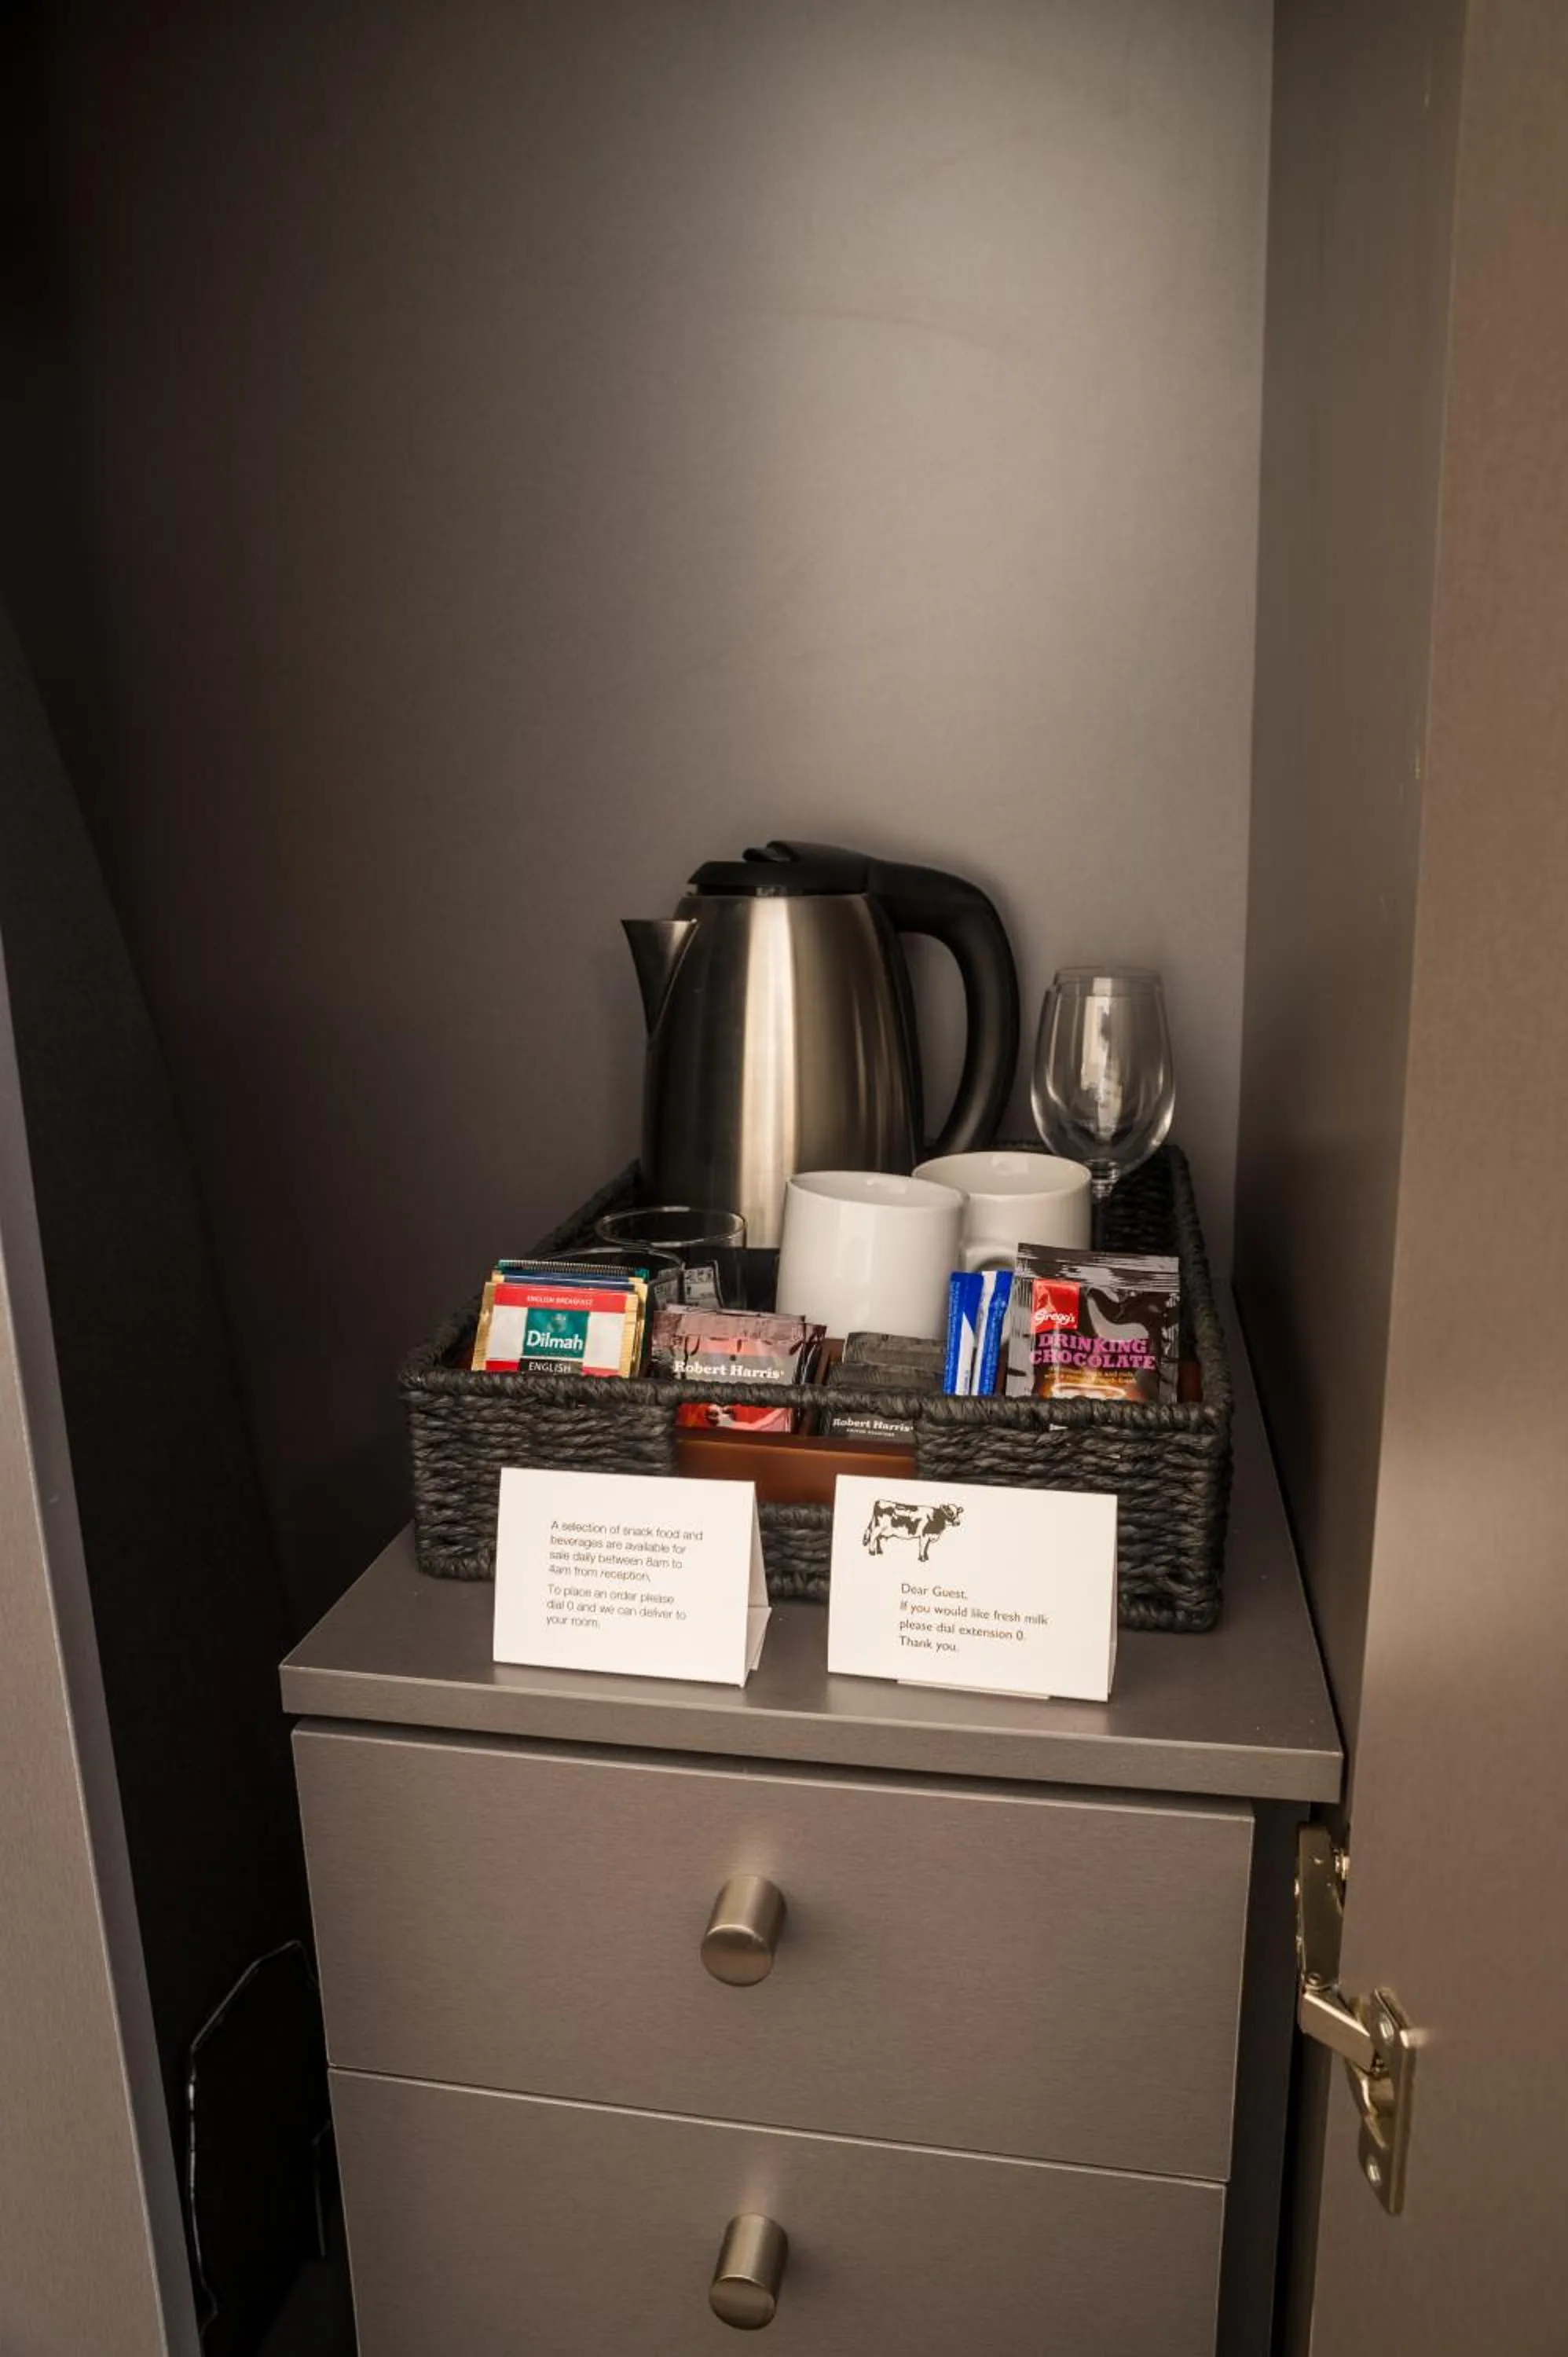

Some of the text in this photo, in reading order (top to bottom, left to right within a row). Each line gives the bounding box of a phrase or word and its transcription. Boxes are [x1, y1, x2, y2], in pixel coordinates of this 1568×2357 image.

[1034, 1307, 1075, 1327] Gregg's
[526, 1330, 584, 1351] Dilmah
[1039, 1333, 1148, 1354] DRINKING
[529, 1362, 572, 1373] ENGLISH
[673, 1360, 780, 1379] Robert Harris
[1030, 1350, 1156, 1370] CHOCOLATE
[833, 1417, 870, 1428] Robert
[874, 1420, 910, 1432] Harris
[551, 1520, 704, 1541] A selection of snack food and
[551, 1535, 687, 1554] beverages are available for
[549, 1551, 683, 1569] sale daily between 8am to
[548, 1563, 571, 1574] 4am
[574, 1567, 598, 1578] from
[548, 1583, 675, 1604] To place an order please
[901, 1583, 929, 1596] Dear
[547, 1600, 687, 1621] dial 0 and we can deliver to
[900, 1600, 1049, 1626] If you would like fresh milk
[546, 1615, 568, 1626] your
[899, 1619, 933, 1632] please
[936, 1622, 955, 1633] dial
[958, 1627, 1013, 1640] extension
[899, 1636, 933, 1648] Thank
